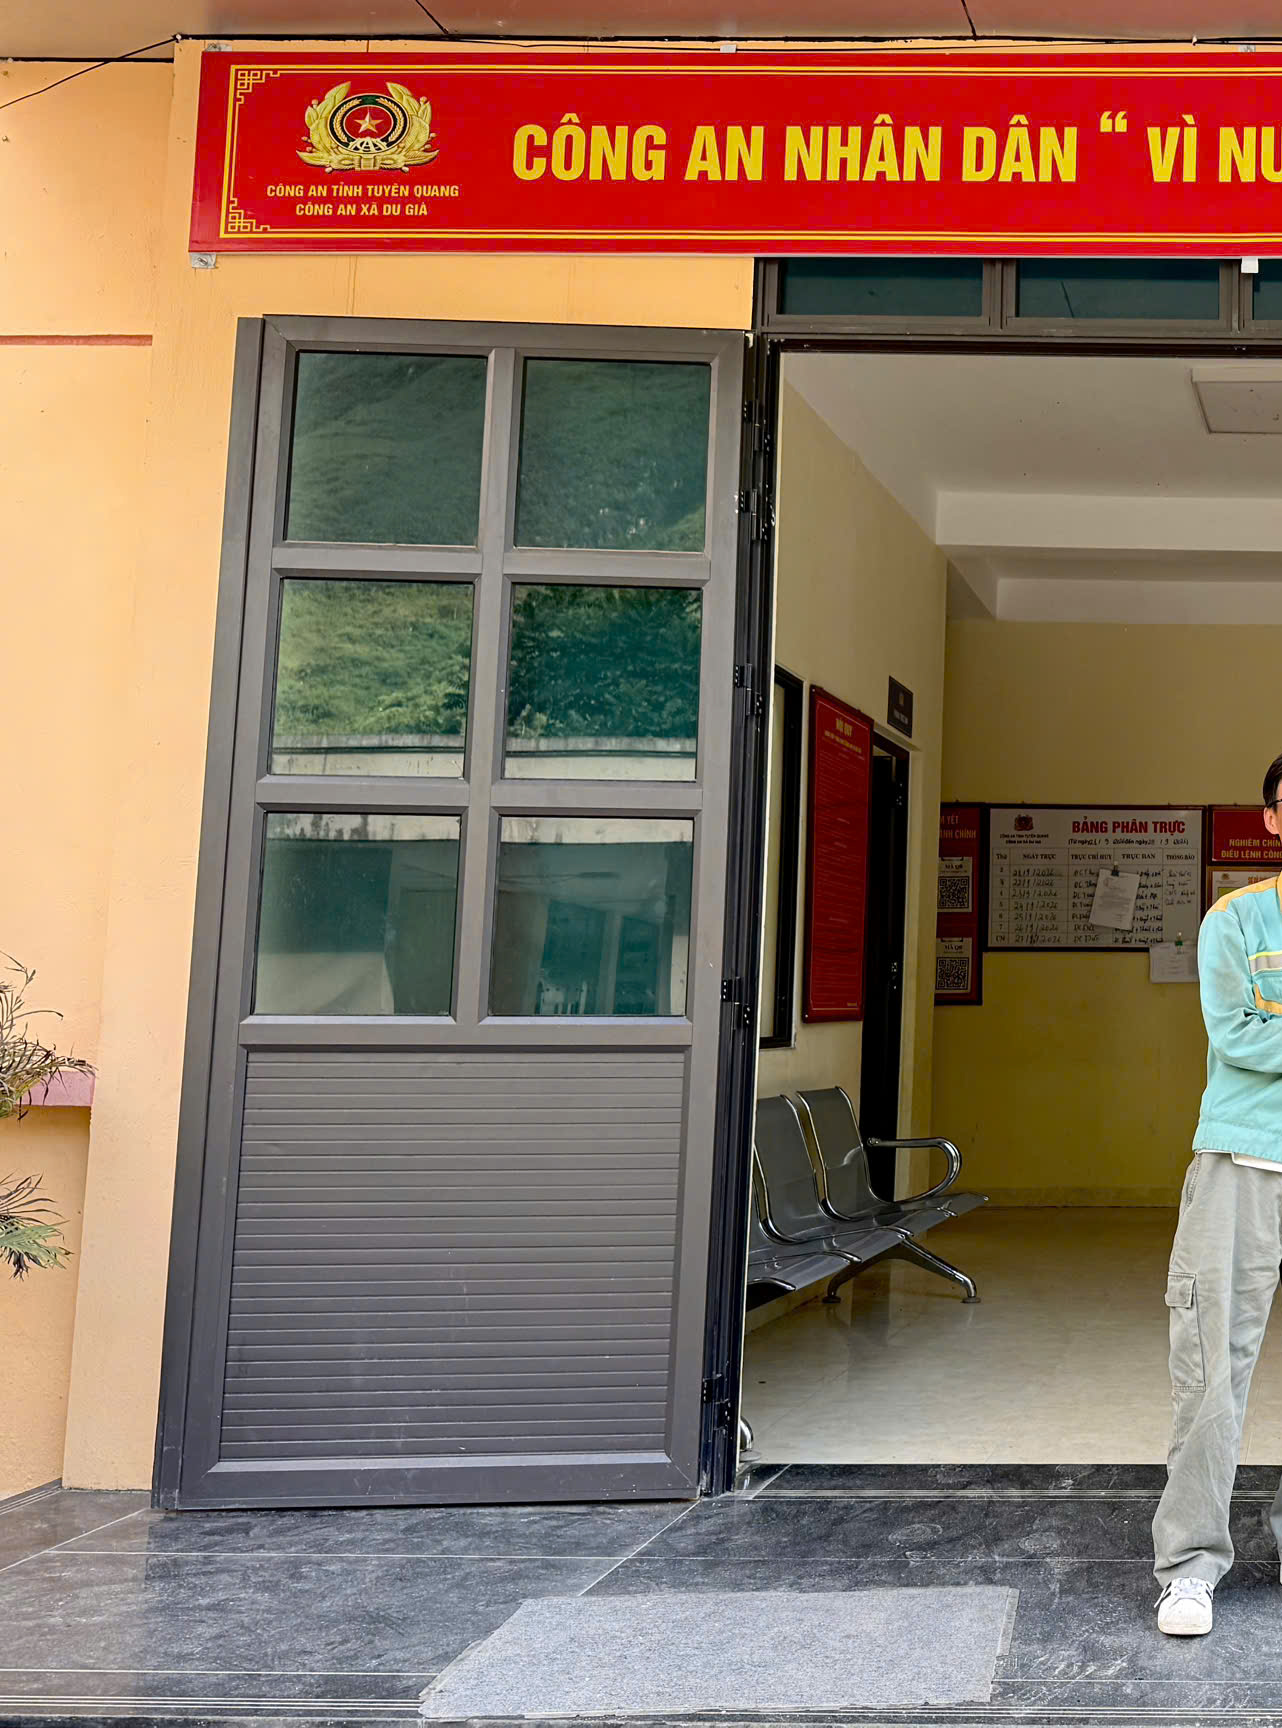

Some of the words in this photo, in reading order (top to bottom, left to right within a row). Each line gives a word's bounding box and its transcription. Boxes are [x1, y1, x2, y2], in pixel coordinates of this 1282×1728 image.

[513, 113, 666, 181] CÔNG
[685, 126, 764, 181] AN
[784, 114, 941, 182] NHÂN
[962, 114, 1077, 182] DÂN
[1147, 114, 1198, 183] VÌ
[267, 183, 304, 197] CÔNG
[308, 185, 327, 197] AN
[332, 181, 362, 197] TỈNH
[367, 182, 409, 197] TUYÊN
[414, 185, 459, 198] QUANG
[296, 202, 333, 216] CÔNG
[337, 204, 356, 216] AN
[361, 202, 378, 216] XÃ
[383, 204, 401, 216] DU
[406, 201, 428, 216] GIÀ
[1072, 816, 1108, 833] BẢNG
[1112, 819, 1148, 834] PHÂN
[1152, 820, 1186, 836] TRỰC
